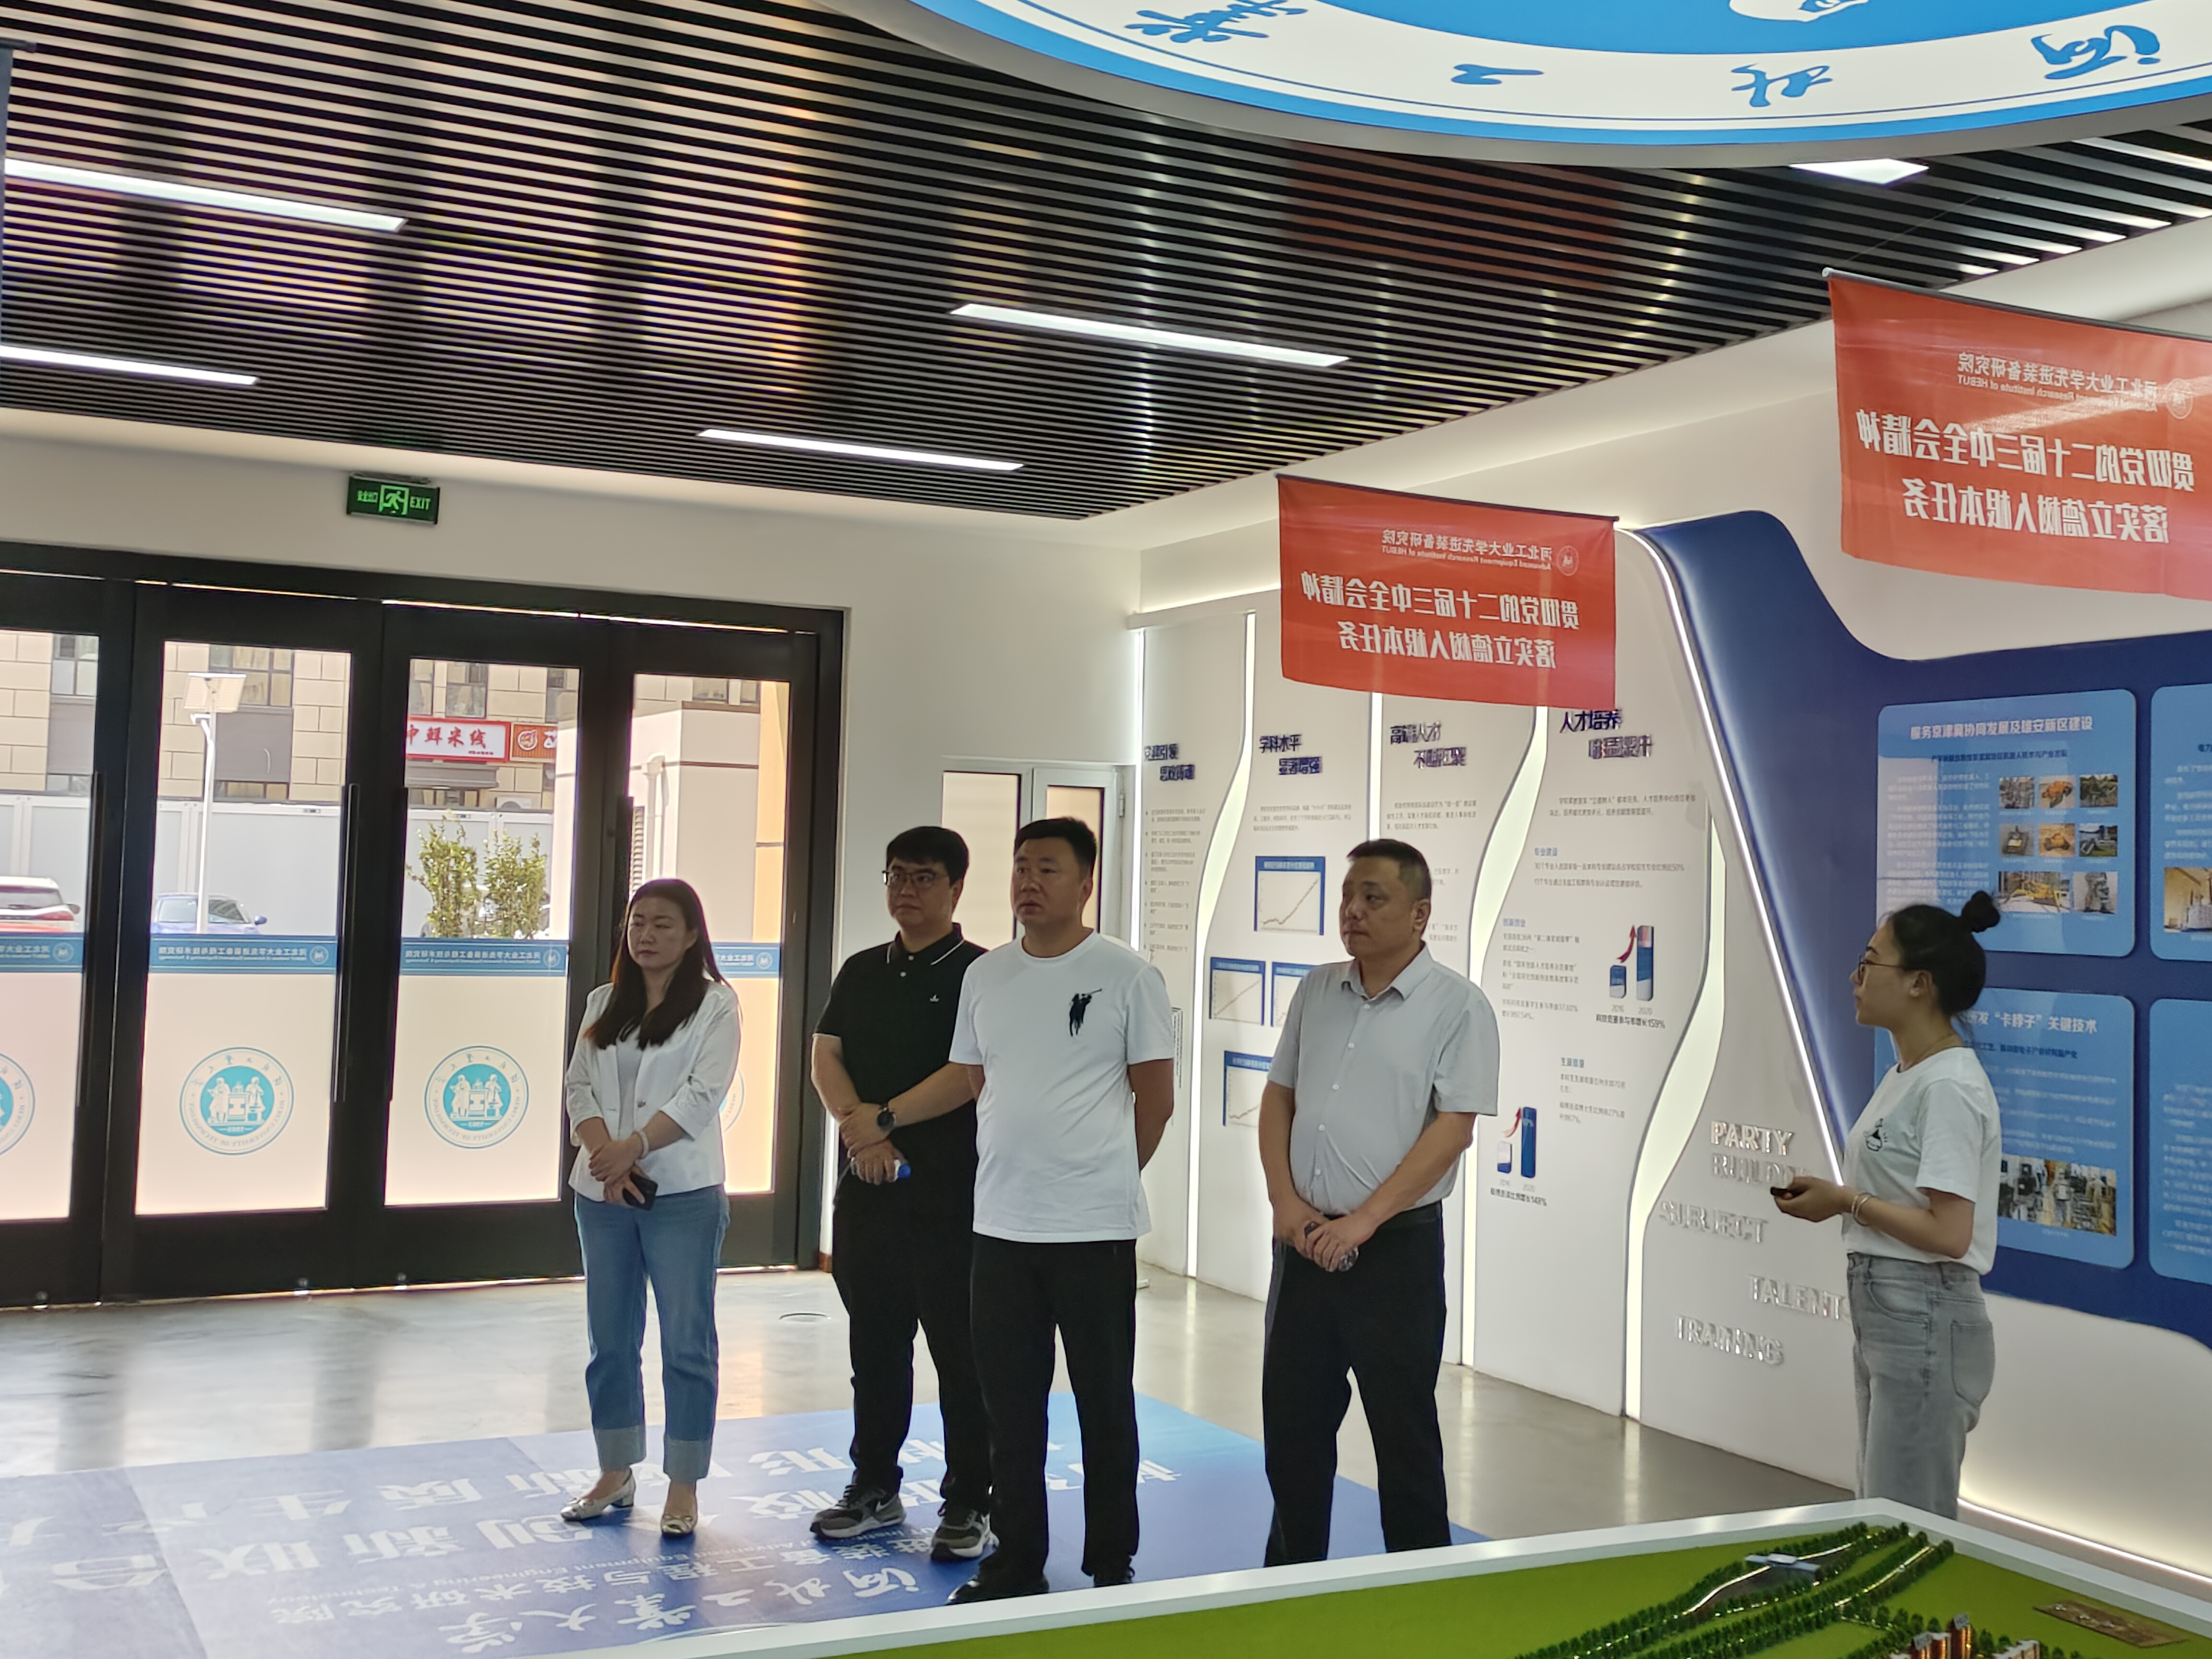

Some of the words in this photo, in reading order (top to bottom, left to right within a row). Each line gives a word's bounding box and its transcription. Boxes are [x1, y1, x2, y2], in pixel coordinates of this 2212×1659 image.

[409, 495, 432, 510] EXIT
[1259, 734, 1302, 753] 学科水平
[1711, 1120, 1795, 1156] PARTY
[1659, 1201, 1769, 1244] SUBJECT
[1676, 1314, 1785, 1366] TRAINING
[573, 1553, 688, 1572] Equipment
[433, 1567, 567, 1586] Engineering
[268, 1586, 402, 1604] Technology
